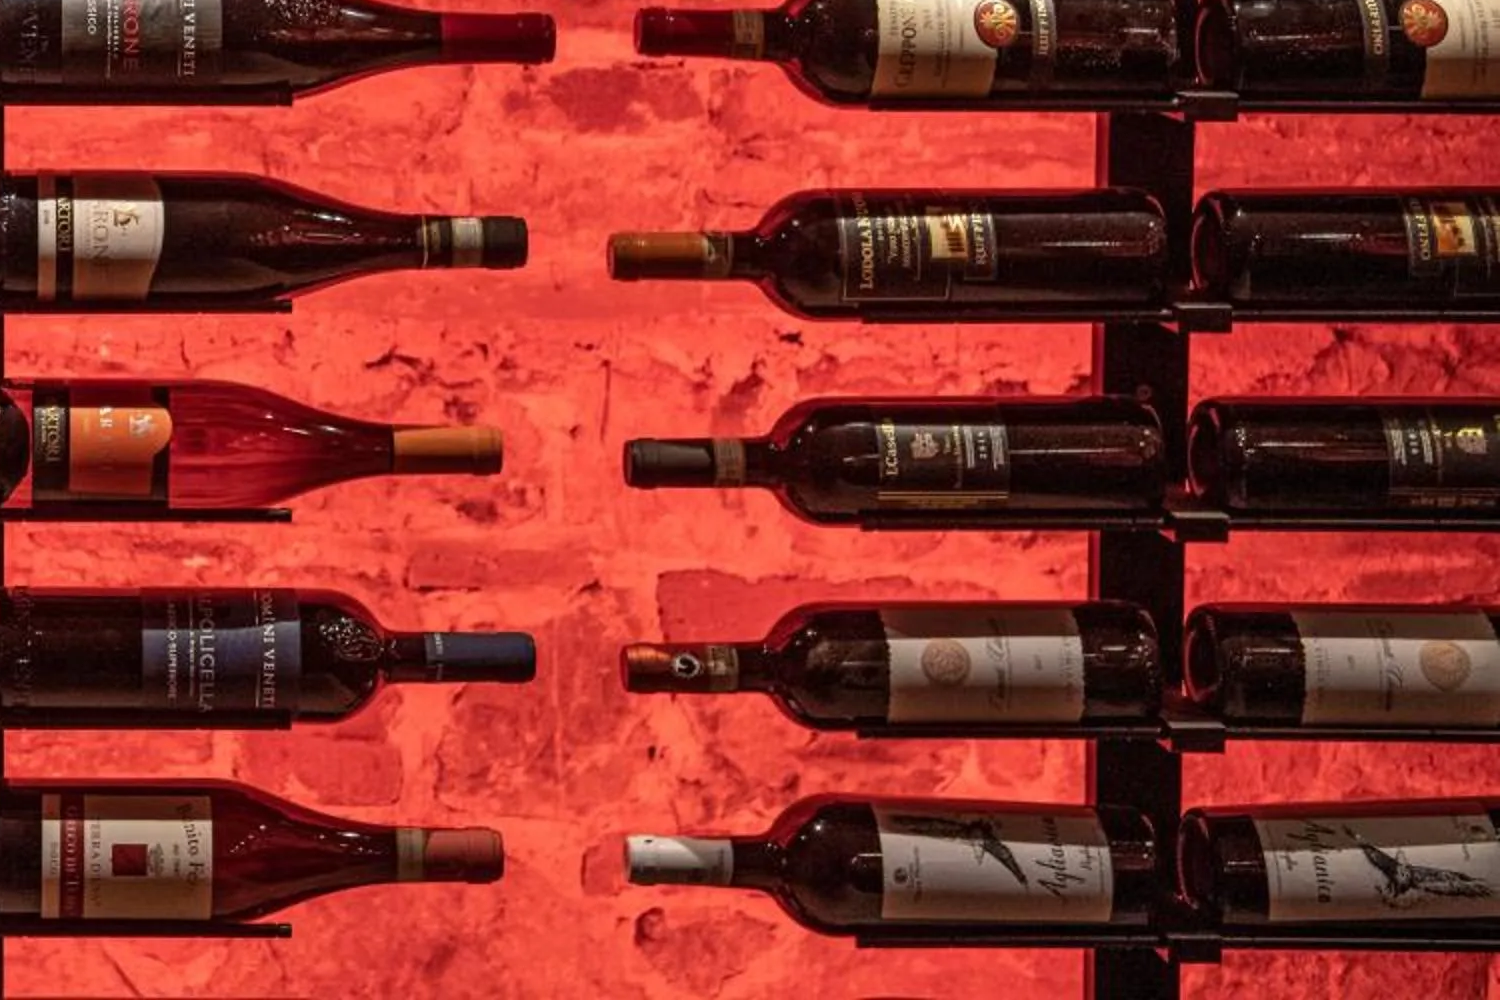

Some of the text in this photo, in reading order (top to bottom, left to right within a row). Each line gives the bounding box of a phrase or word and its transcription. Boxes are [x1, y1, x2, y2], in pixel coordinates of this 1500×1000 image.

[182, 13, 197, 77] VENETI
[261, 647, 276, 708] VENETI
[1288, 820, 1336, 904] Aglianico
